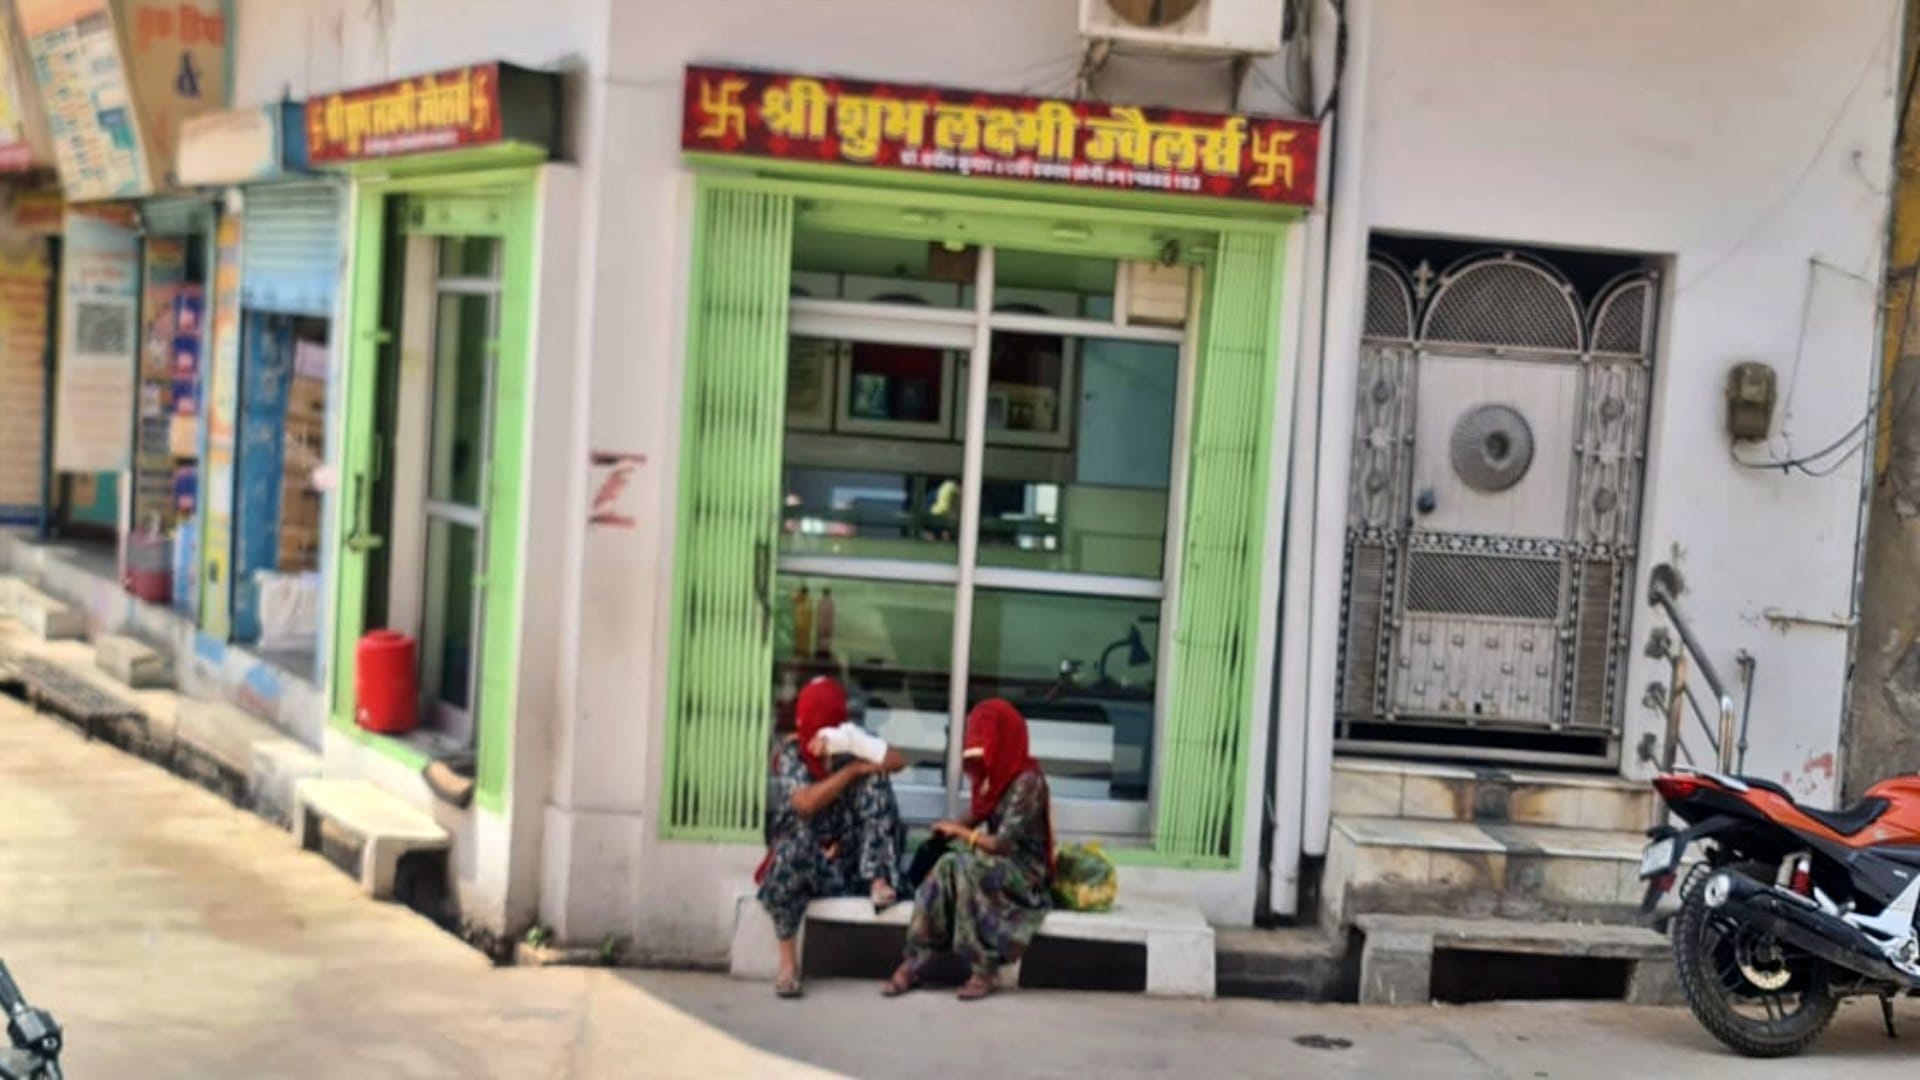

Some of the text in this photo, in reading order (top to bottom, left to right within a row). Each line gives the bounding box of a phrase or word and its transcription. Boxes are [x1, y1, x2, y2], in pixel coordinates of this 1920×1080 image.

[761, 78, 1248, 177] श्री शुभ लक्ष्मी ज्वैलर्स
